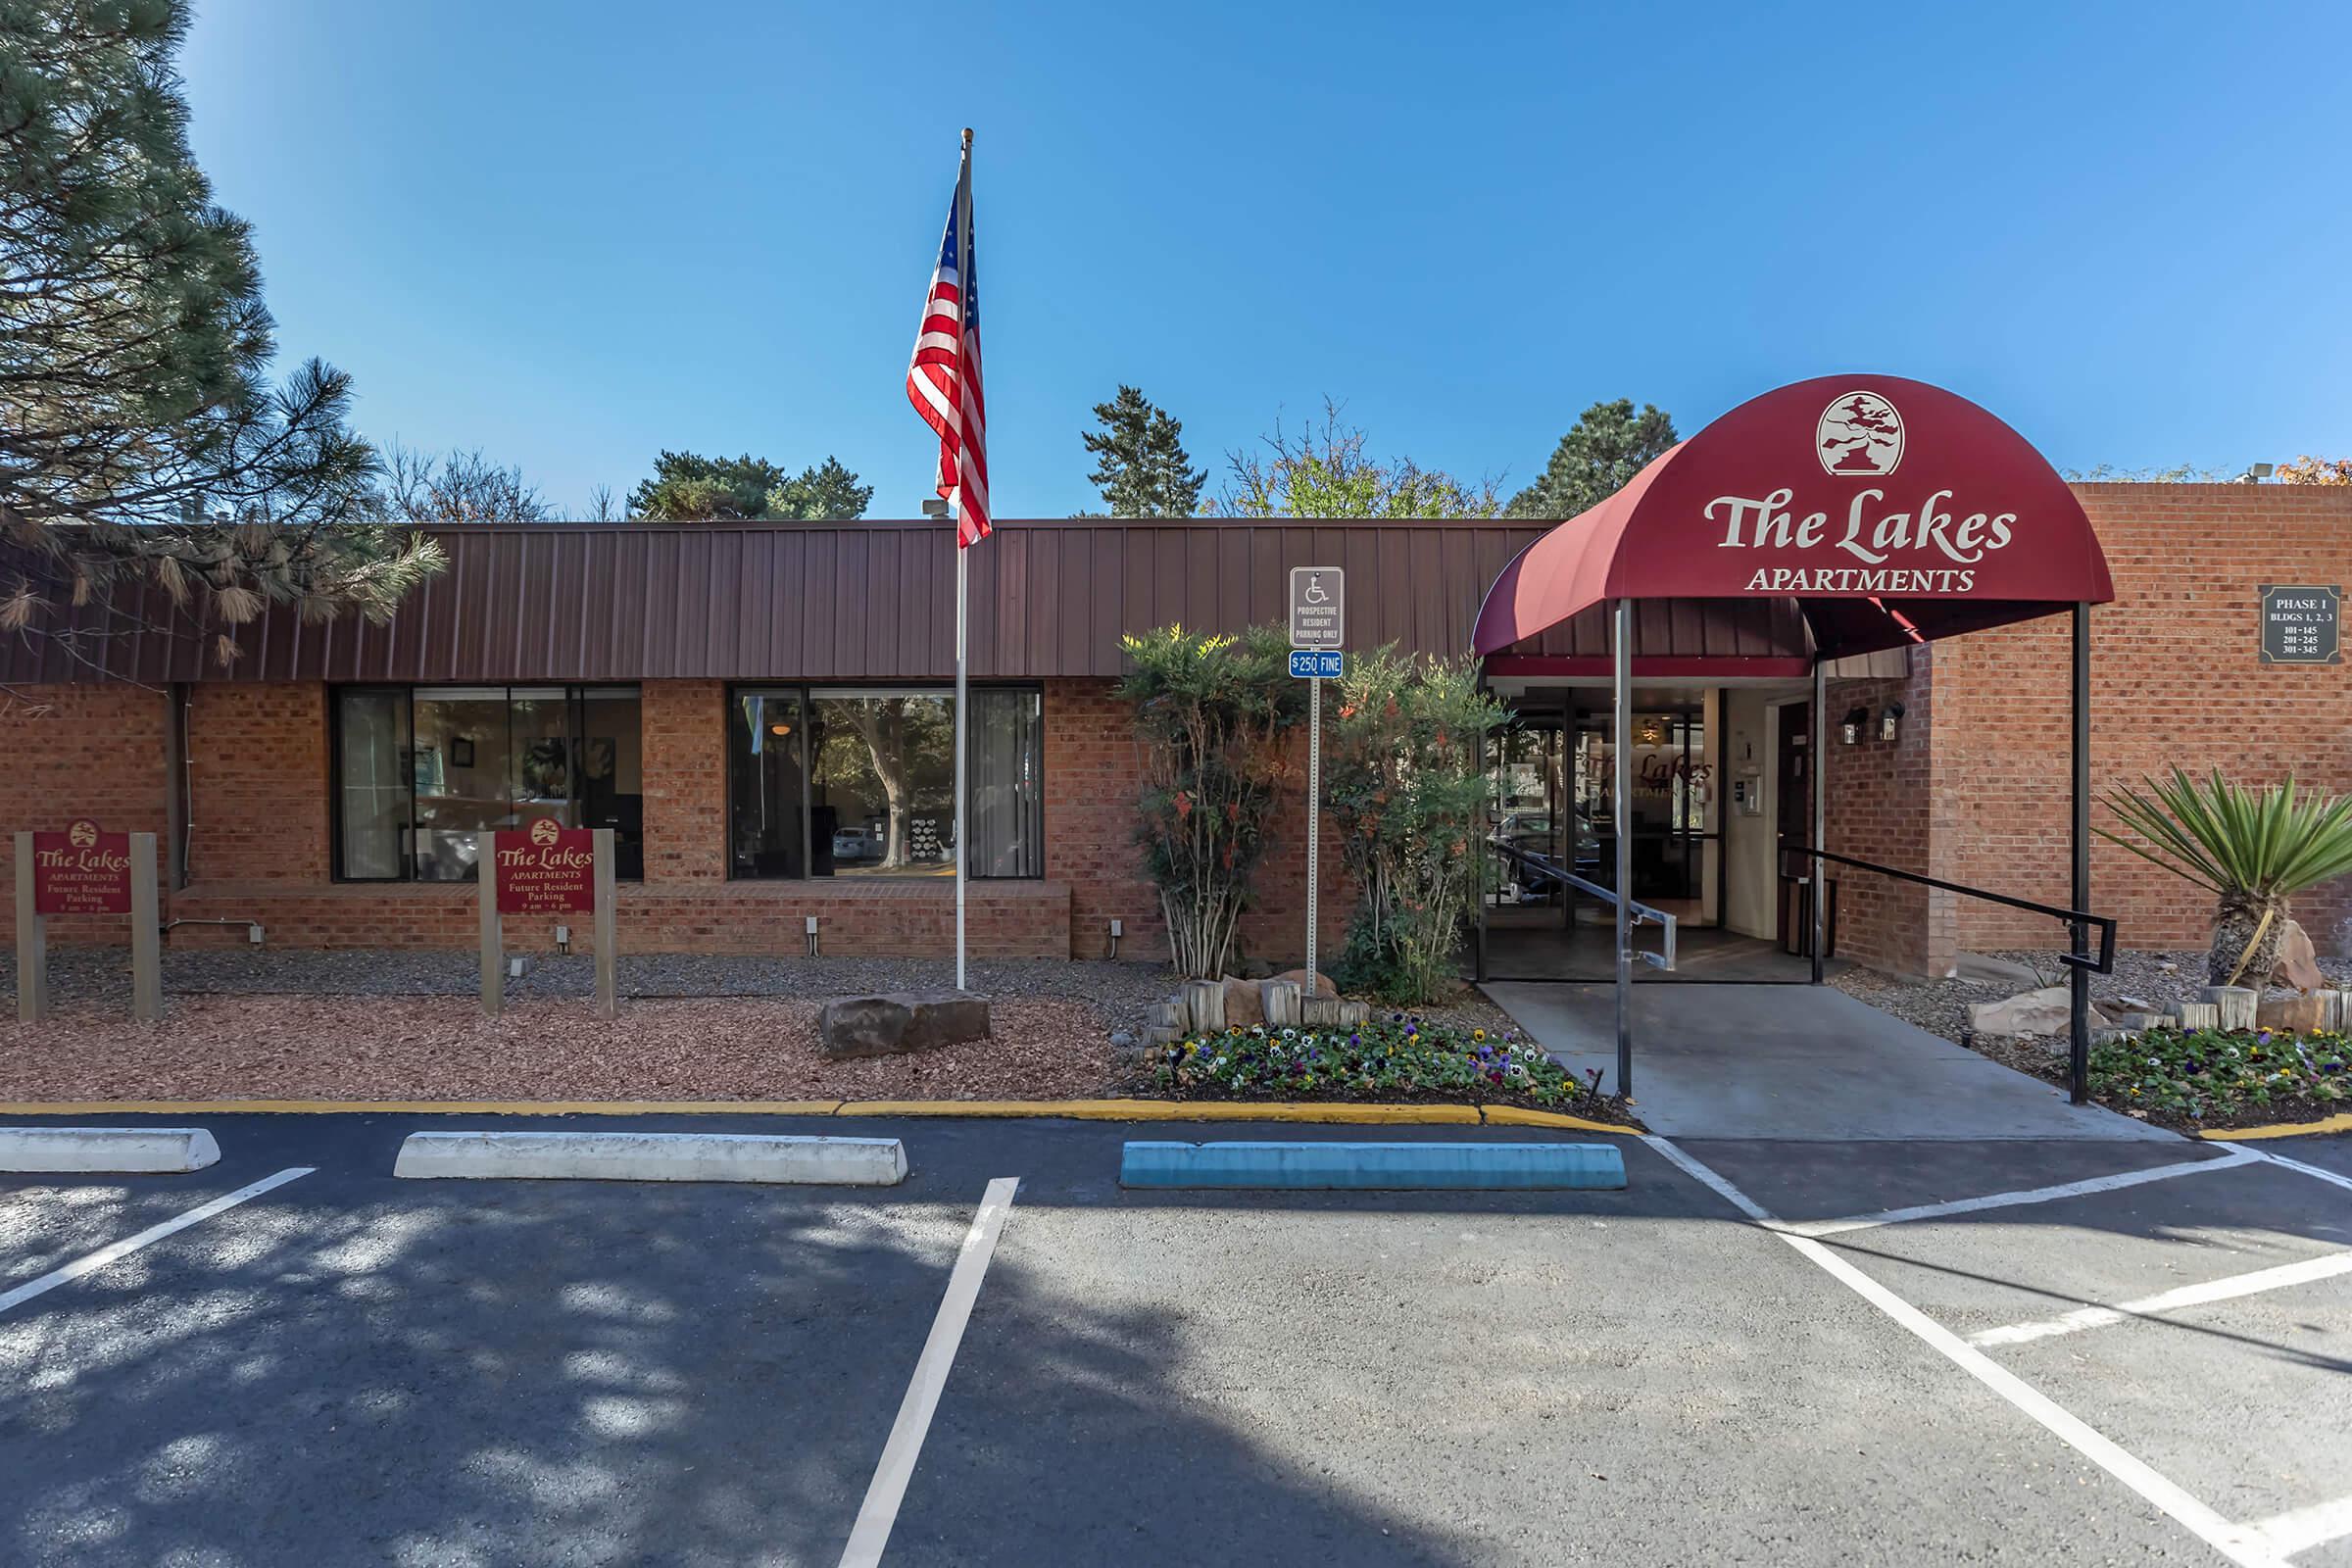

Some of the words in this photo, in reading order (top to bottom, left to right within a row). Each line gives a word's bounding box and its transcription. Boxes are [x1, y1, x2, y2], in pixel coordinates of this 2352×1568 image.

[1703, 487, 1828, 549] The
[1835, 488, 2019, 565] Lakes
[1744, 567, 1976, 593] APARTMENTS
[2277, 599, 2318, 610] PHASE
[1298, 607, 1337, 615] PROSPECTIVE
[2306, 613, 2313, 622] 1,
[2316, 613, 2324, 622] 2,
[2282, 645, 2318, 654] 301-345
[1320, 658, 1341, 671] FINE
[1640, 754, 1713, 787] Lakes
[35, 849, 74, 867] The
[77, 849, 132, 872] Lakes
[497, 847, 535, 866] The
[539, 846, 594, 870] Lakes
[47, 884, 78, 894] Future
[81, 884, 122, 894] Resident
[509, 883, 540, 892] Future
[544, 882, 583, 892] Resident
[67, 893, 103, 904] Parking
[528, 892, 565, 902] Parking
